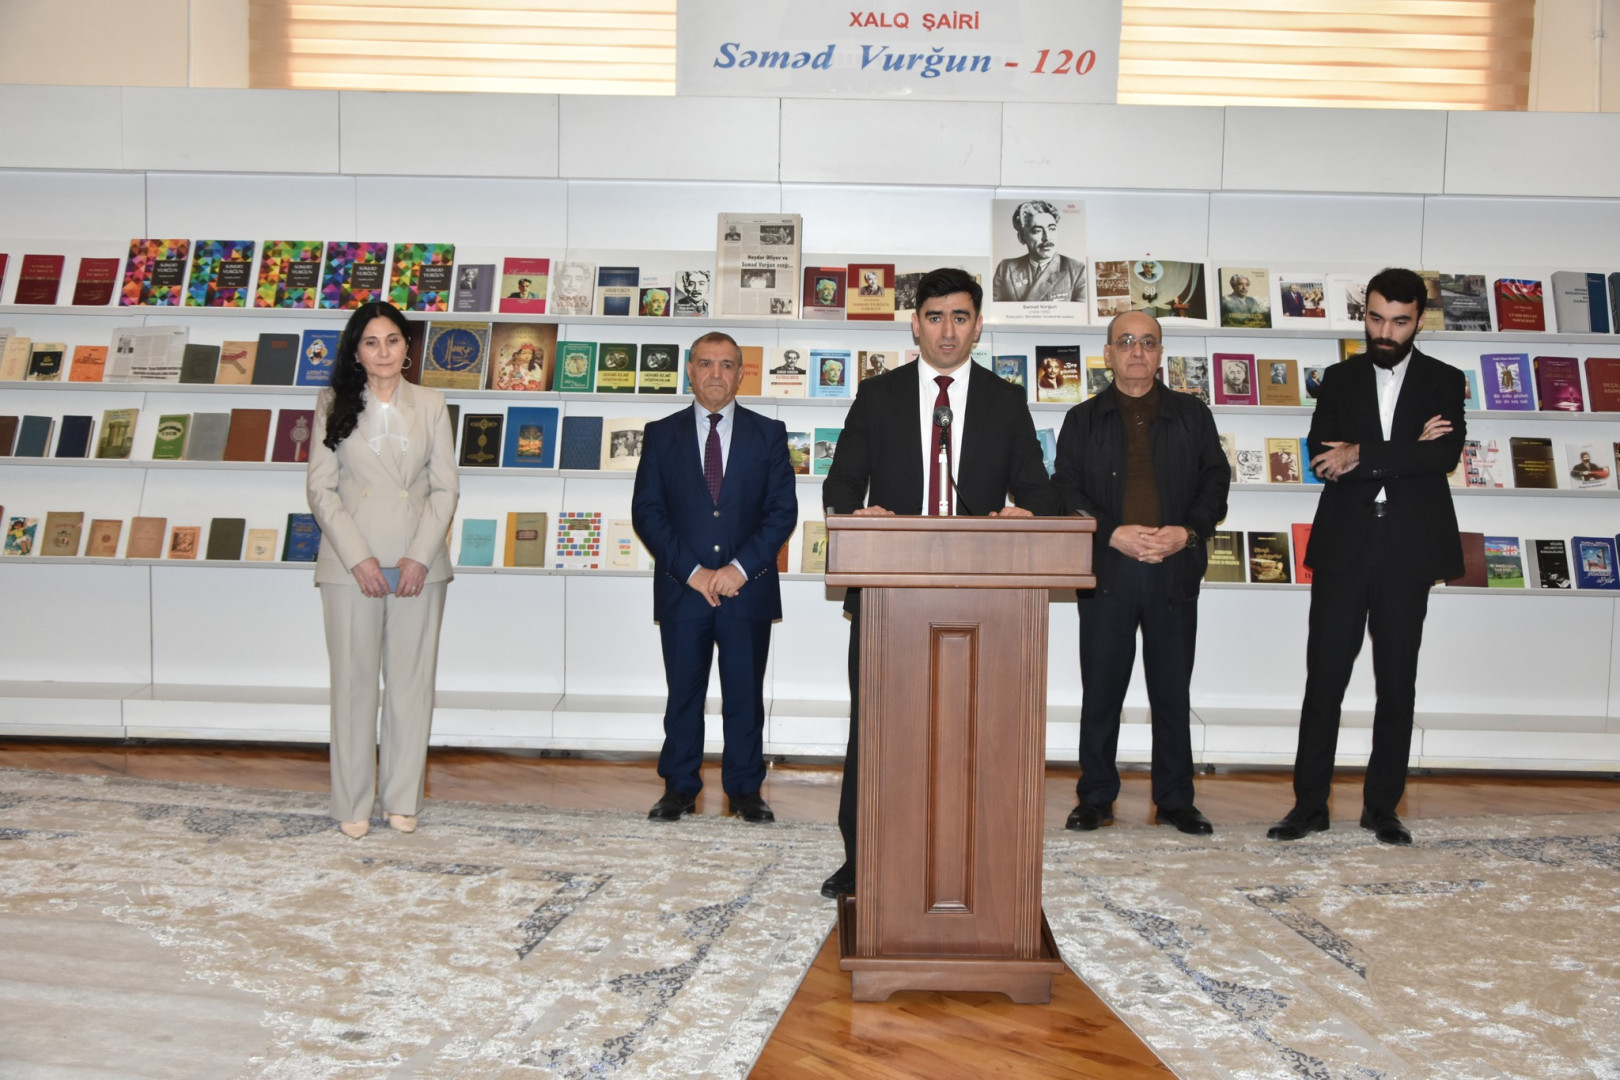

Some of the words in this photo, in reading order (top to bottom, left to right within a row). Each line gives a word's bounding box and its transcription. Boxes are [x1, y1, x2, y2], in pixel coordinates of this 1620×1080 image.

[849, 12, 909, 30] XALQ
[922, 11, 980, 32] ŞAİRİ
[713, 43, 837, 70] Səməd
[859, 45, 992, 79] Vurğun
[1030, 49, 1097, 75] 120
[1144, 286, 1156, 296] 90
